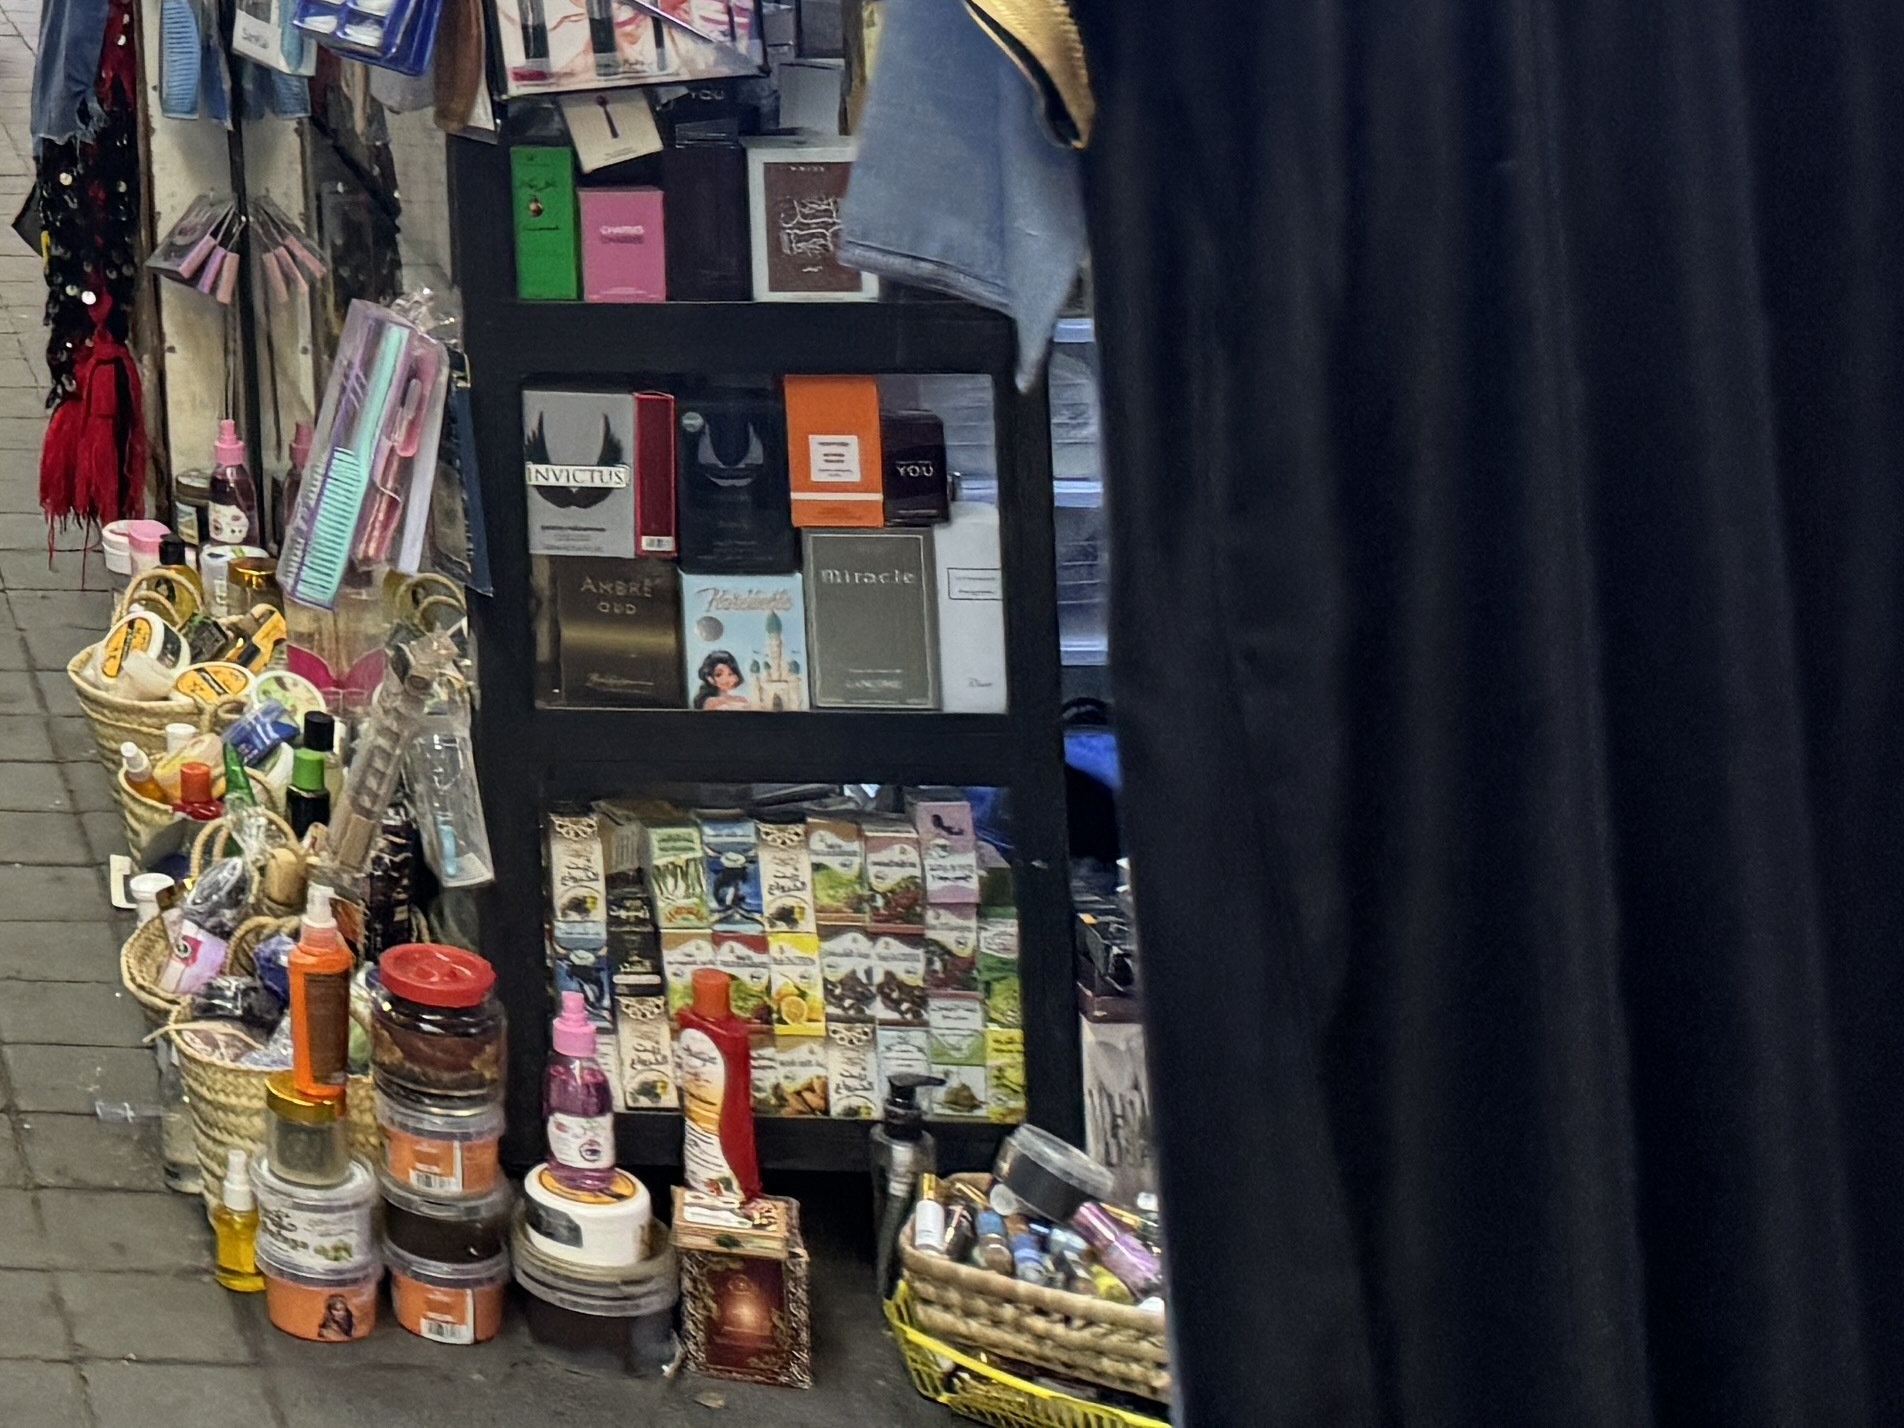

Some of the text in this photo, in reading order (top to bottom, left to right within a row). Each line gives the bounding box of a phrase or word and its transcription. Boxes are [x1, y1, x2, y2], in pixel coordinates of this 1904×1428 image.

[528, 465, 624, 487] INVICTUS
[896, 464, 935, 478] YOU
[820, 567, 918, 586] Miracle
